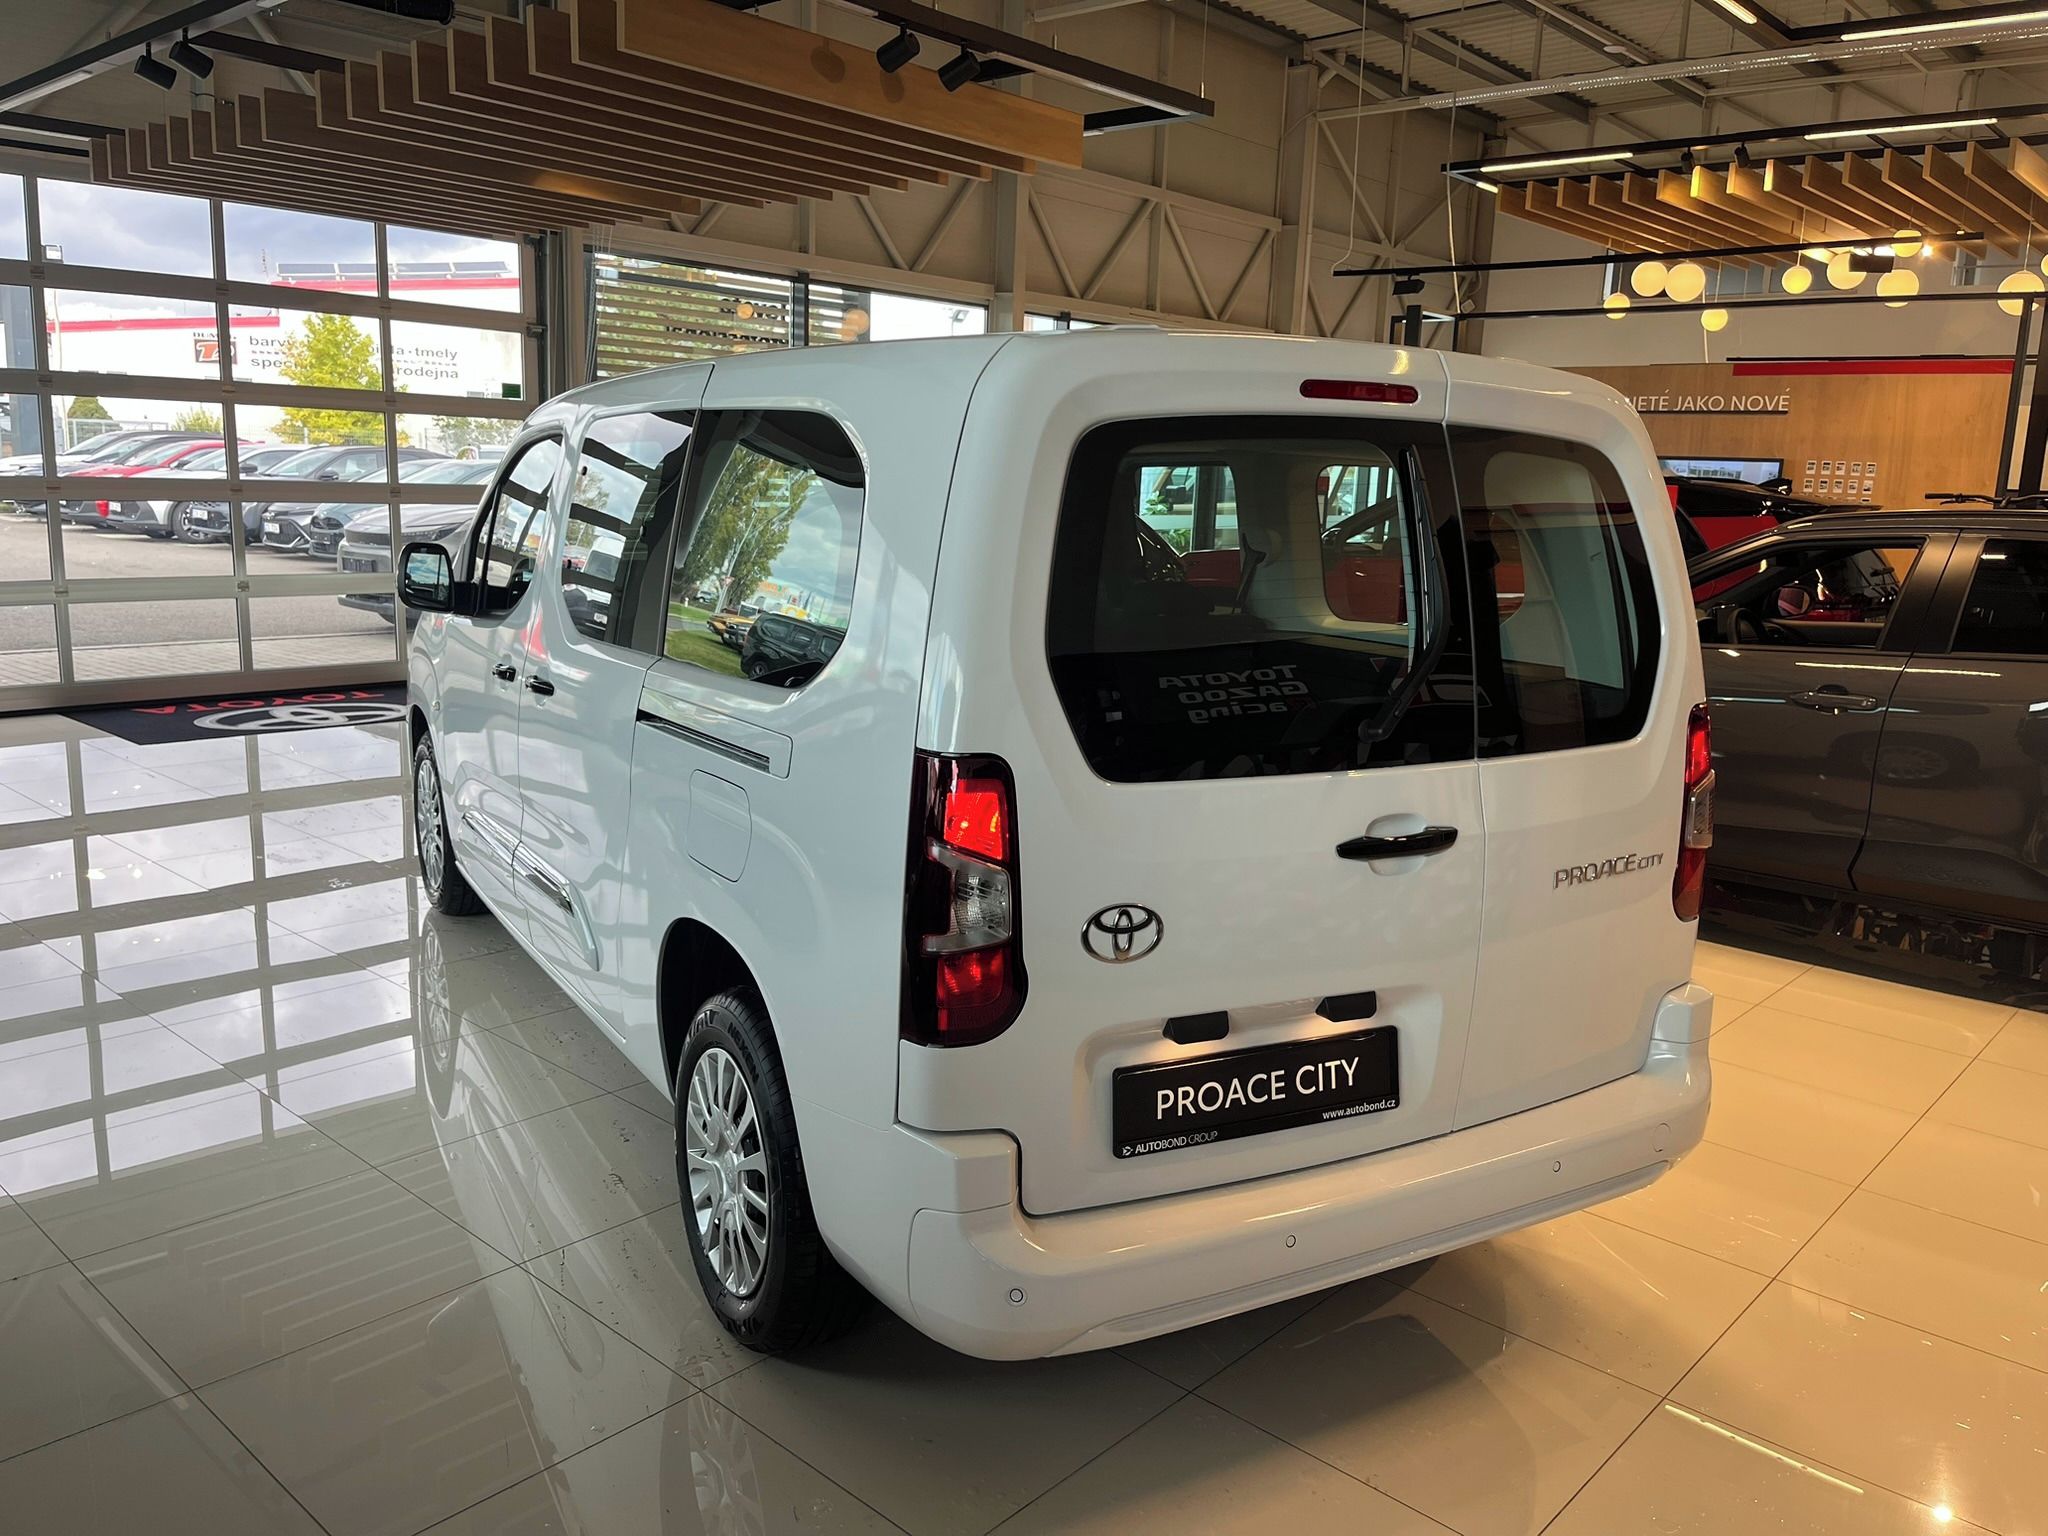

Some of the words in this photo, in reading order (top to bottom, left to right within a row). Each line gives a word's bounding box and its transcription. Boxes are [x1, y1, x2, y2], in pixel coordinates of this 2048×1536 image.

[415, 346, 458, 361] tmely
[395, 366, 459, 380] rodejna
[1672, 395, 1725, 411] JAKO
[1730, 387, 1791, 411] NOVÉ
[132, 692, 384, 714] TOYOTA
[1553, 853, 1637, 890] PROACE
[1638, 853, 1664, 870] CITY
[727, 1022, 760, 1083] NEXEN
[1156, 1070, 1286, 1120] PROACE
[1295, 1057, 1360, 1095] CITY
[1322, 1099, 1396, 1120] www.autobond.cz
[1134, 1136, 1187, 1155] AUTOBOND
[1188, 1131, 1218, 1145] GROUP
